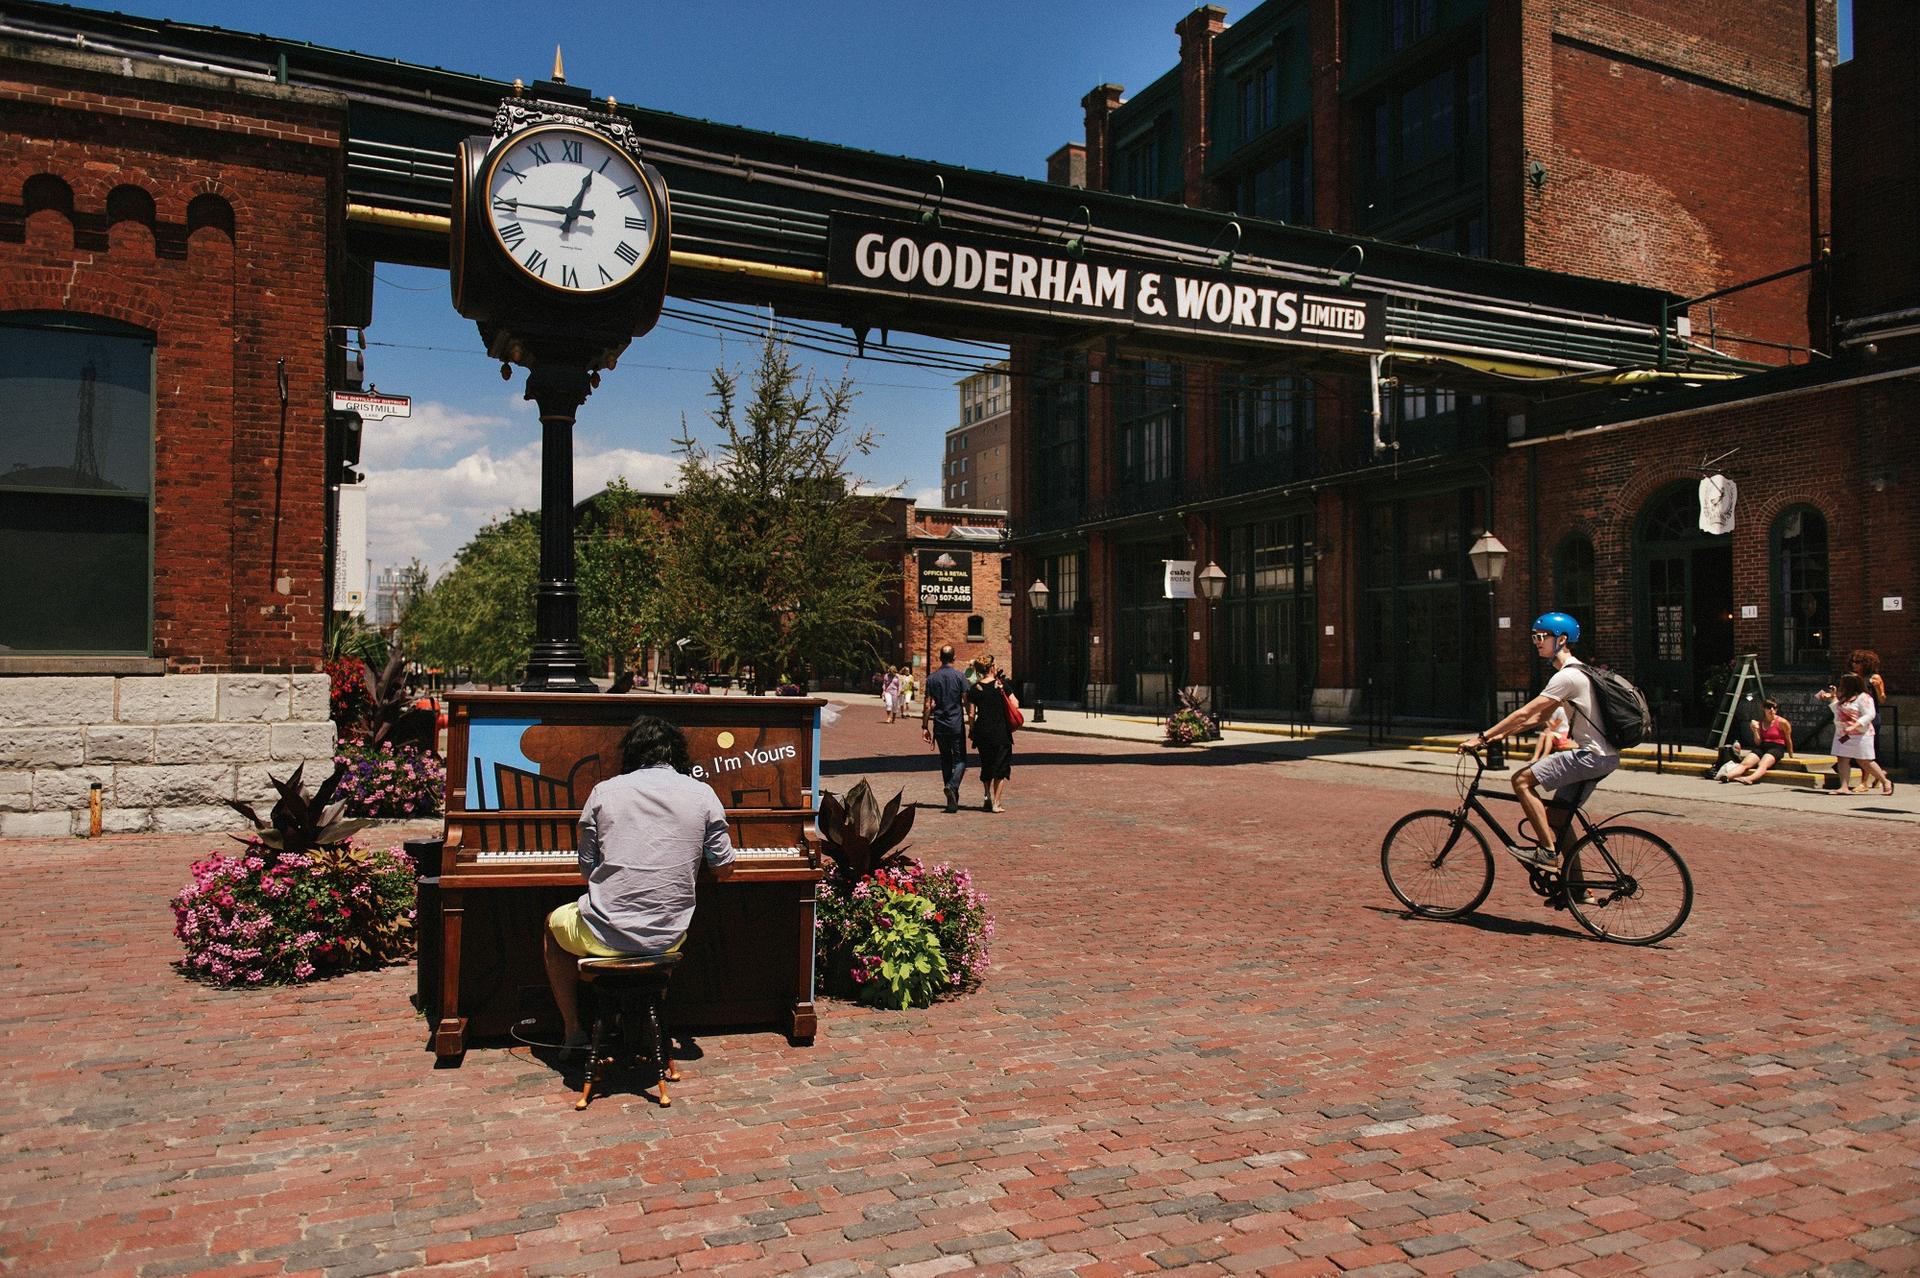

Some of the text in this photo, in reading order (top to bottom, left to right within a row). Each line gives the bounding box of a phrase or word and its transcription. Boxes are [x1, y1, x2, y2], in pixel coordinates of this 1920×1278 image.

[855, 233, 1366, 332] GOODERHAM & WORTS LIMITED
[345, 402, 398, 414] GRISTMILL
[921, 584, 971, 594] FOR LEASE
[939, 594, 971, 602] 507-3450
[1893, 599, 1899, 608] 9
[689, 745, 796, 779] e, I'm Yours
